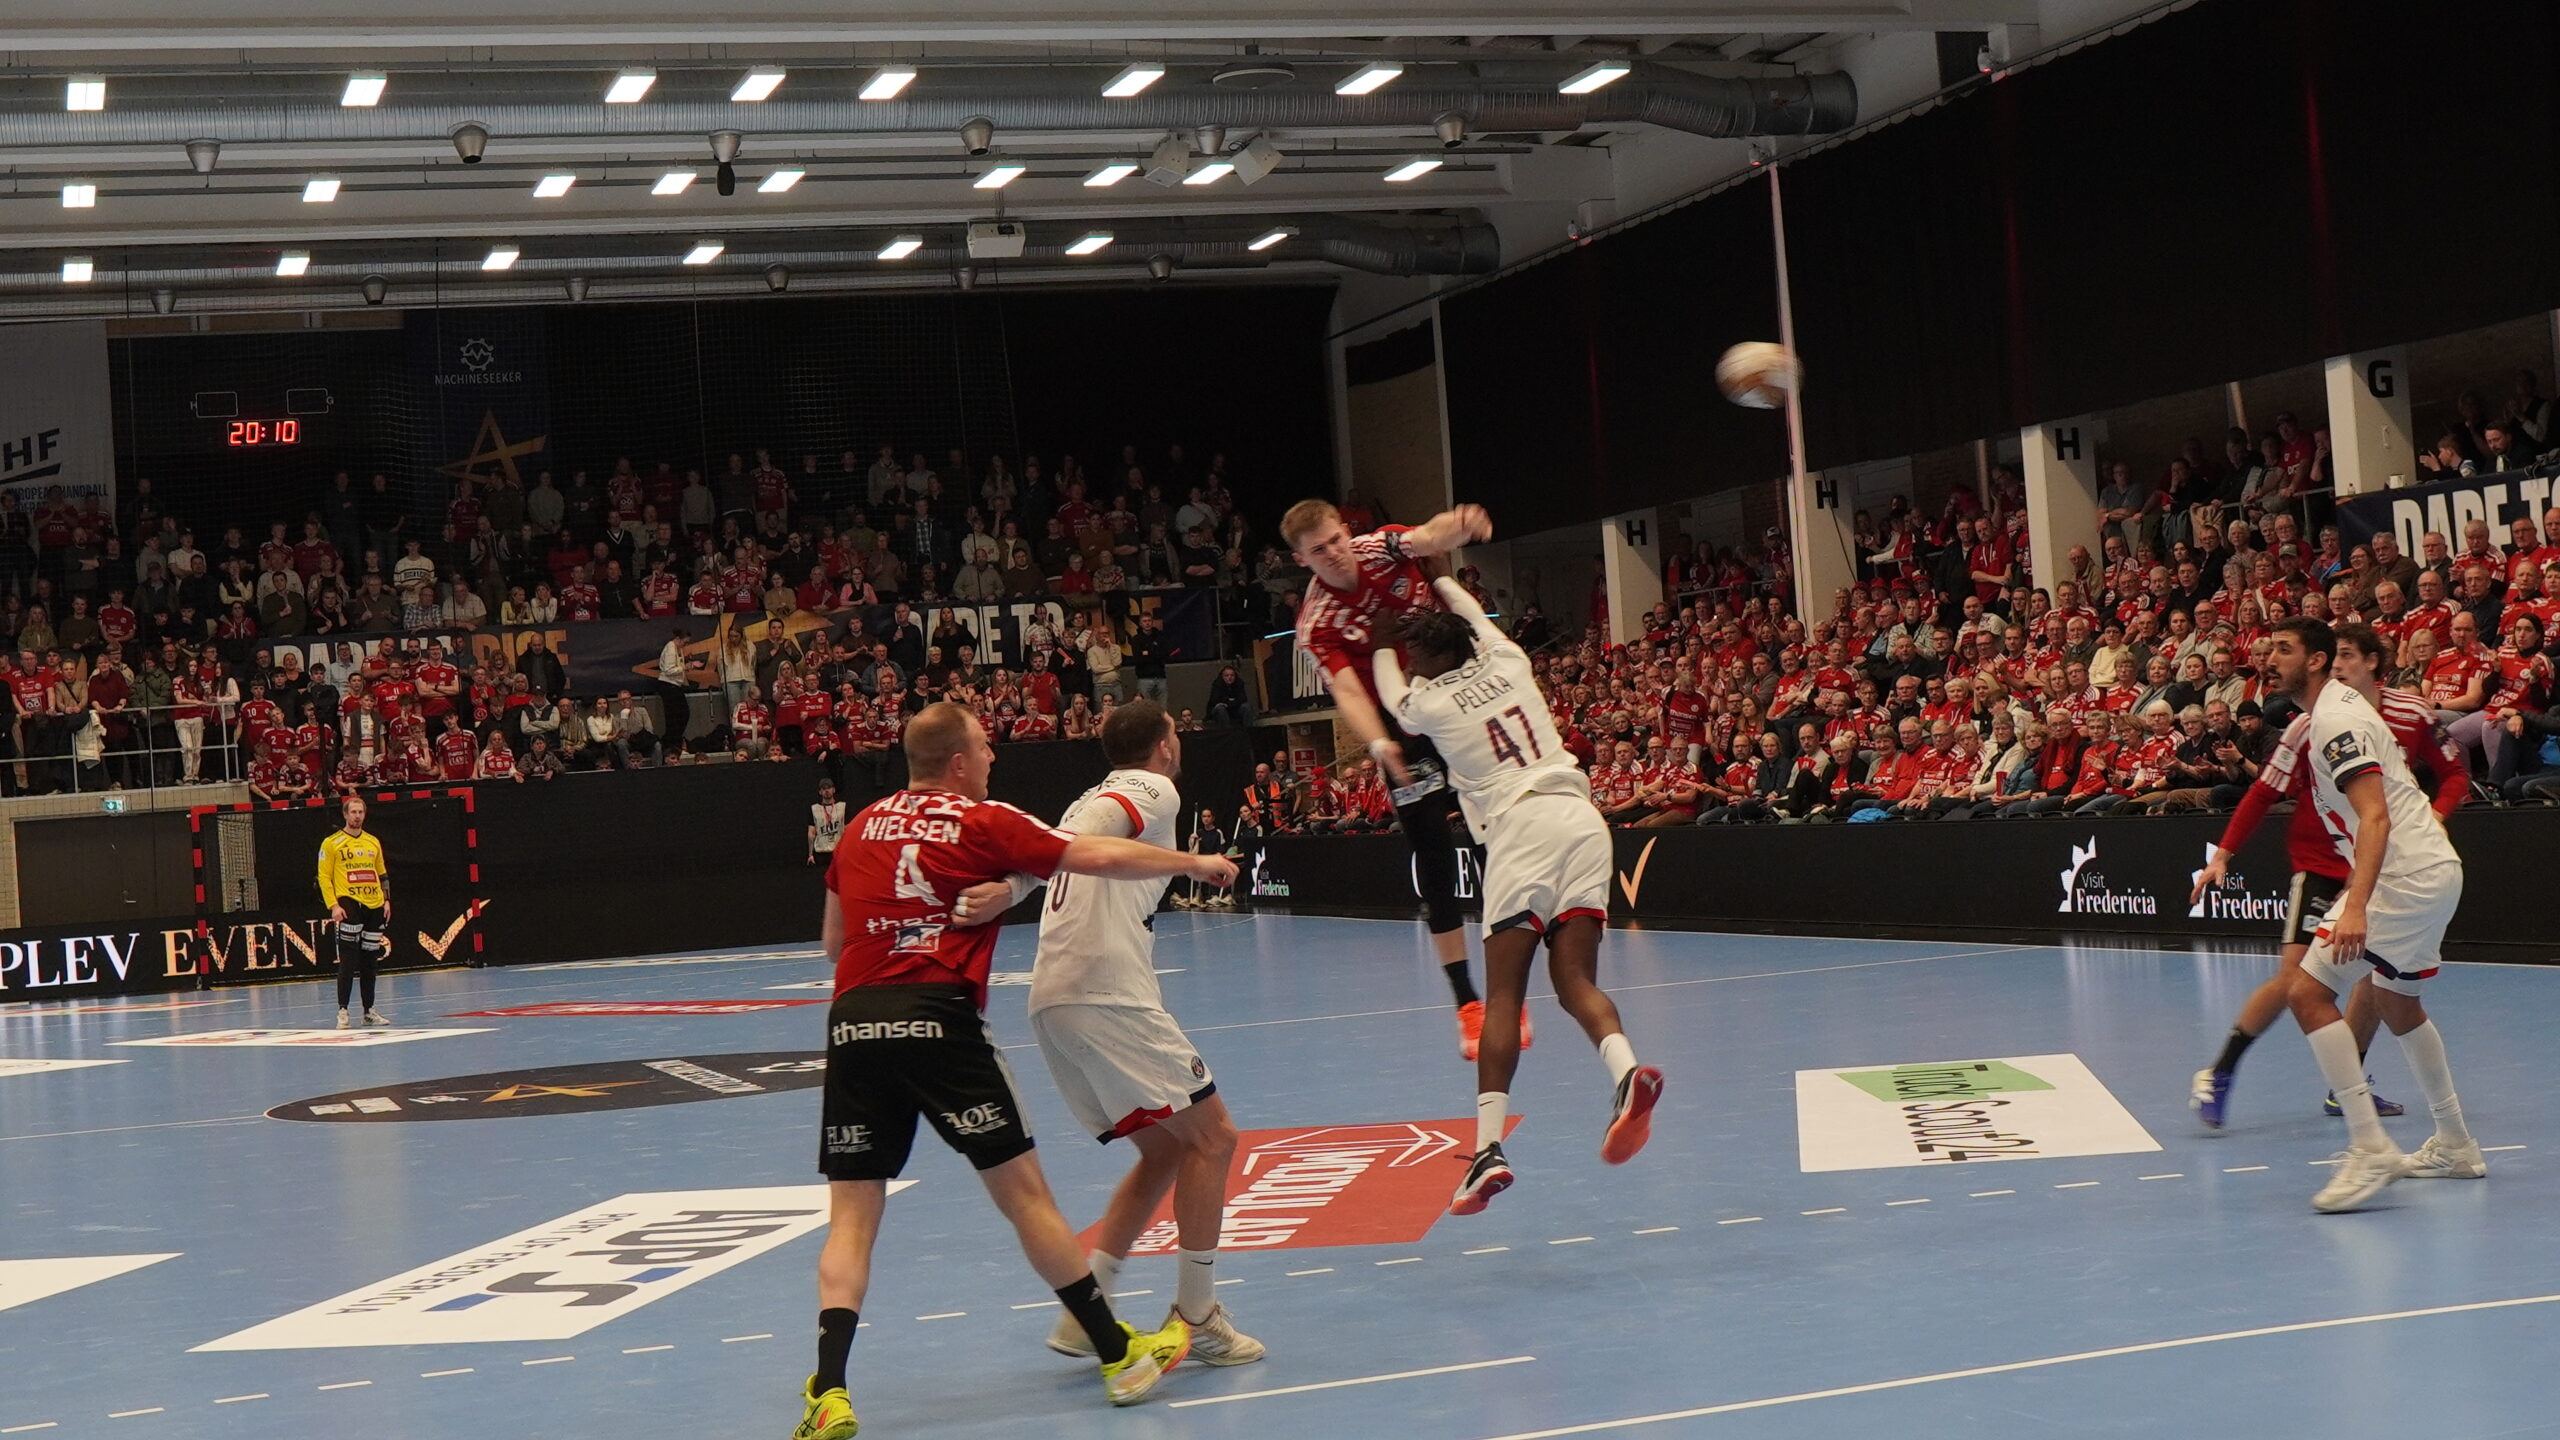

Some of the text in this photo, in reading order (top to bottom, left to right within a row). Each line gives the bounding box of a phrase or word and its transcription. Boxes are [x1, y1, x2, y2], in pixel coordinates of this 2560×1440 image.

[434, 370, 523, 386] MACHINESEEKER
[2367, 360, 2395, 398] G
[229, 421, 298, 445] 20:10
[2055, 427, 2081, 461] H
[1815, 480, 1840, 509] H
[1626, 519, 1648, 547] H
[1452, 674, 1516, 715] PELEKA
[1485, 704, 1542, 768] 47
[1126, 778, 1160, 800] QNB
[860, 816, 962, 845] NIELSEN
[339, 848, 354, 861] 16
[894, 844, 945, 906] 4
[2081, 871, 2106, 889] Visit
[2075, 888, 2157, 915] Fredericia
[2210, 890, 2289, 920] Frederic
[832, 1020, 944, 1046] thansen
